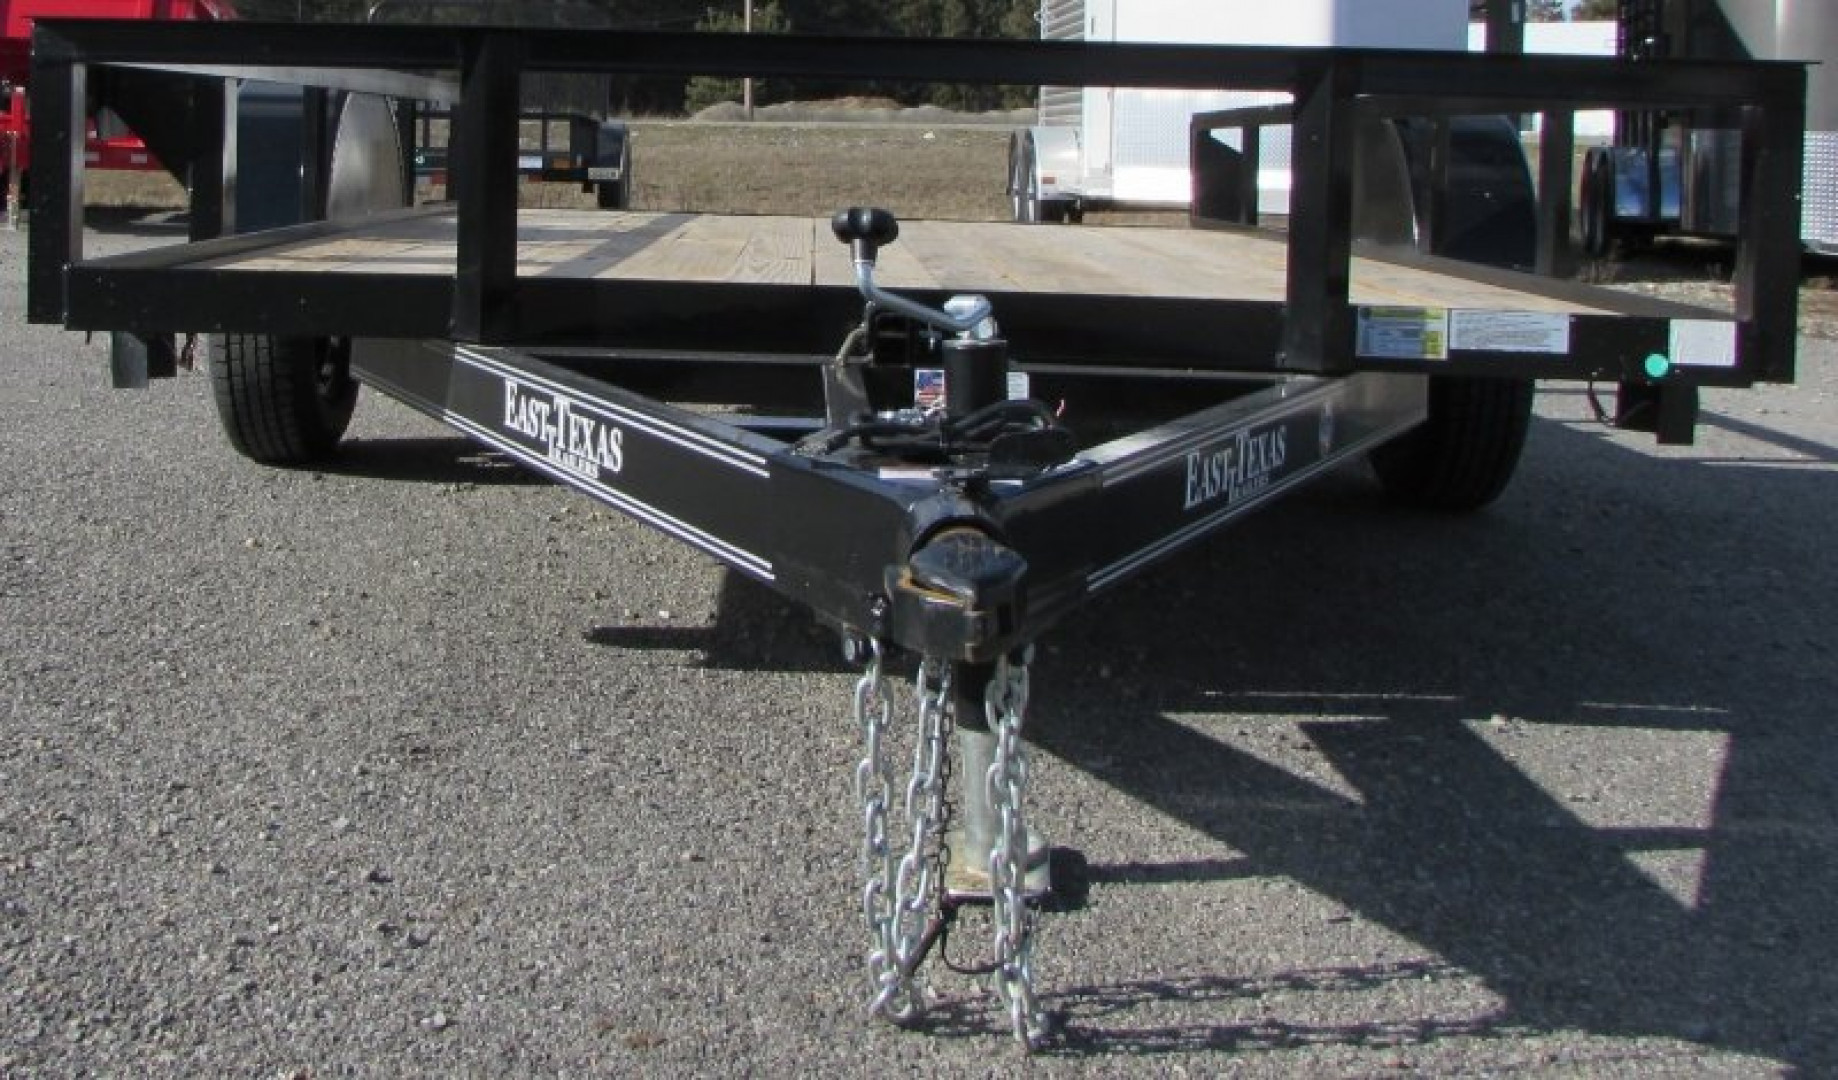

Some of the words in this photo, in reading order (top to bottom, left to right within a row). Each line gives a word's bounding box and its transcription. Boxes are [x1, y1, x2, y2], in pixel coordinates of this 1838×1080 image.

[504, 377, 550, 442] EAST
[553, 394, 624, 473] TEXAS
[1184, 448, 1232, 510] EAST
[1236, 426, 1287, 485] TEXAS
